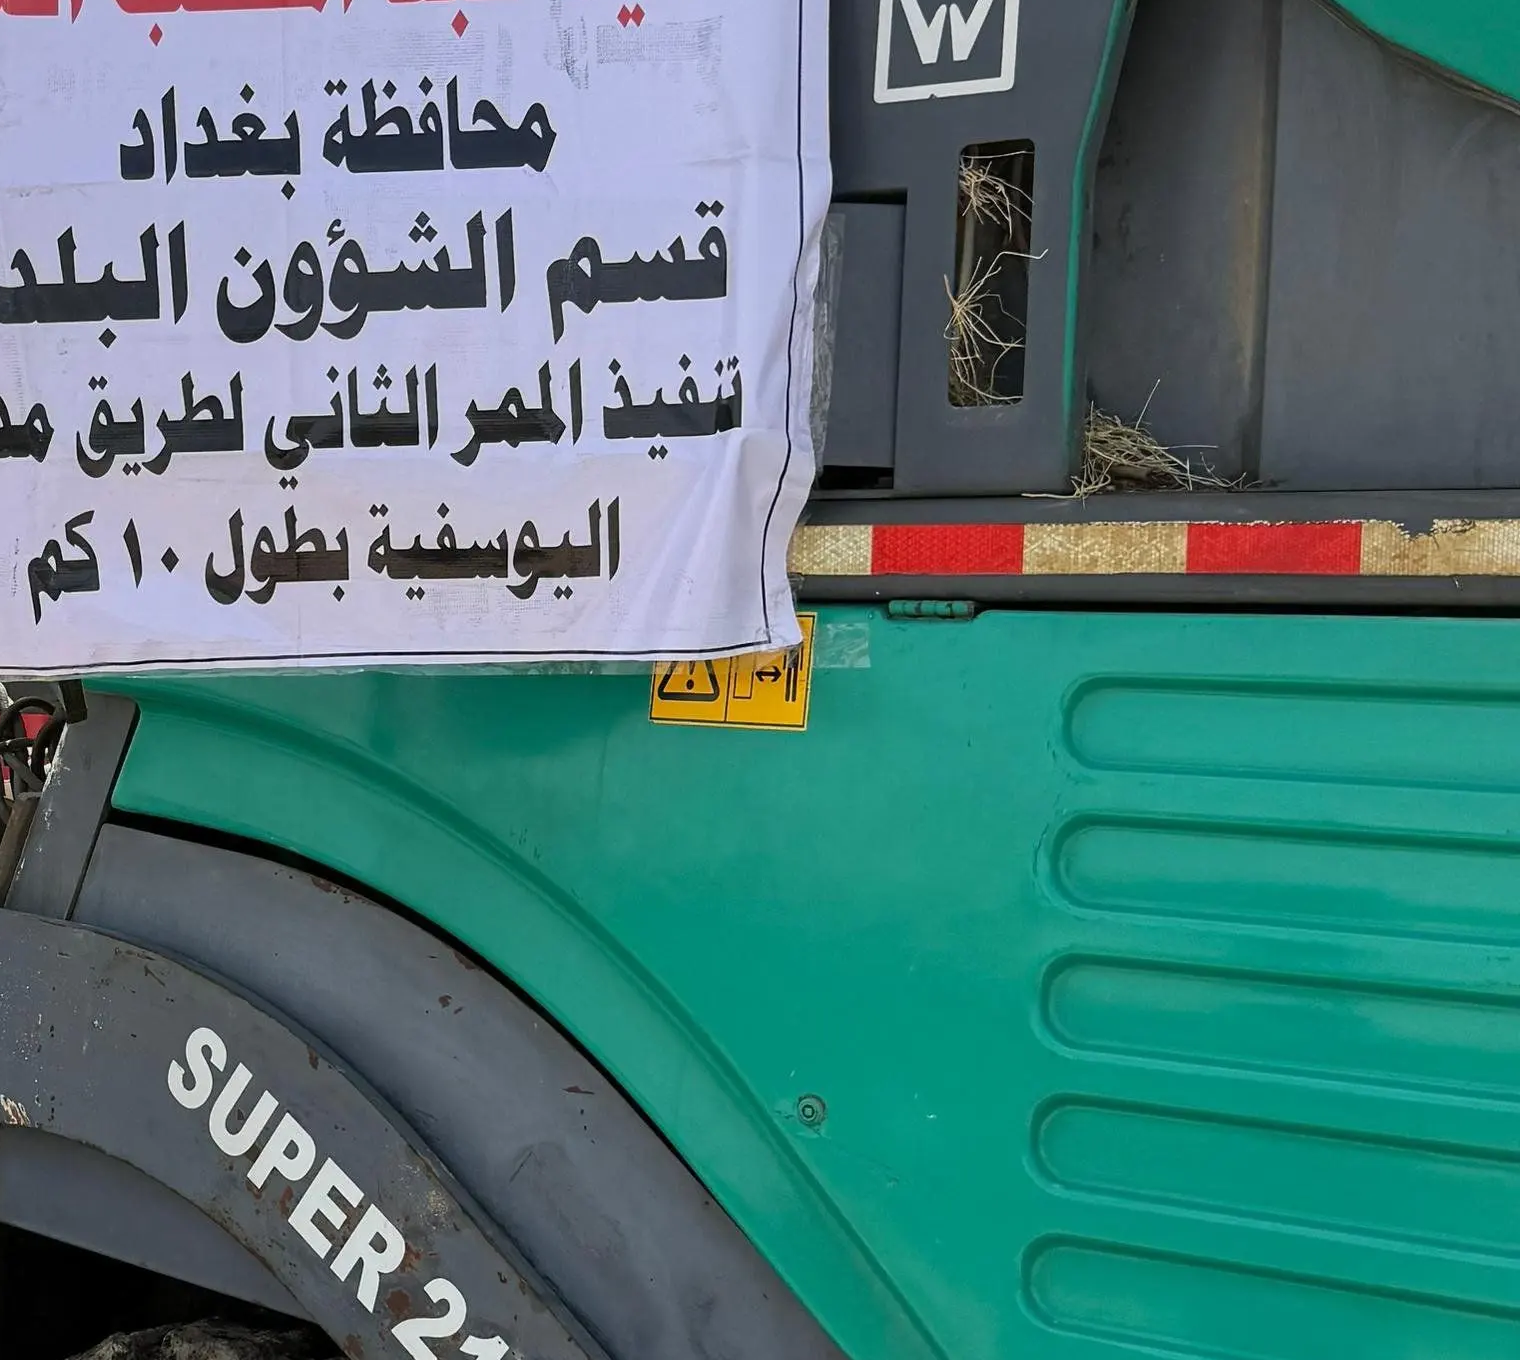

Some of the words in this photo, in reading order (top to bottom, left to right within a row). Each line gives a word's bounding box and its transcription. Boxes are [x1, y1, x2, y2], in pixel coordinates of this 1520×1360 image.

[120, 84, 300, 200] بغداد
[323, 75, 556, 173] محافظة
[217, 208, 515, 343] الشؤون
[547, 201, 727, 344] قسم
[77, 371, 243, 478] لطريق
[265, 363, 438, 489] الثاني
[450, 358, 582, 466] الممر
[603, 354, 742, 459] تنفيذ
[28, 511, 99, 625] كم
[123, 518, 179, 588] ١٠
[205, 505, 349, 604] بطول
[368, 496, 619, 600] اليوسفية
[167, 1027, 406, 1314] SUPER
